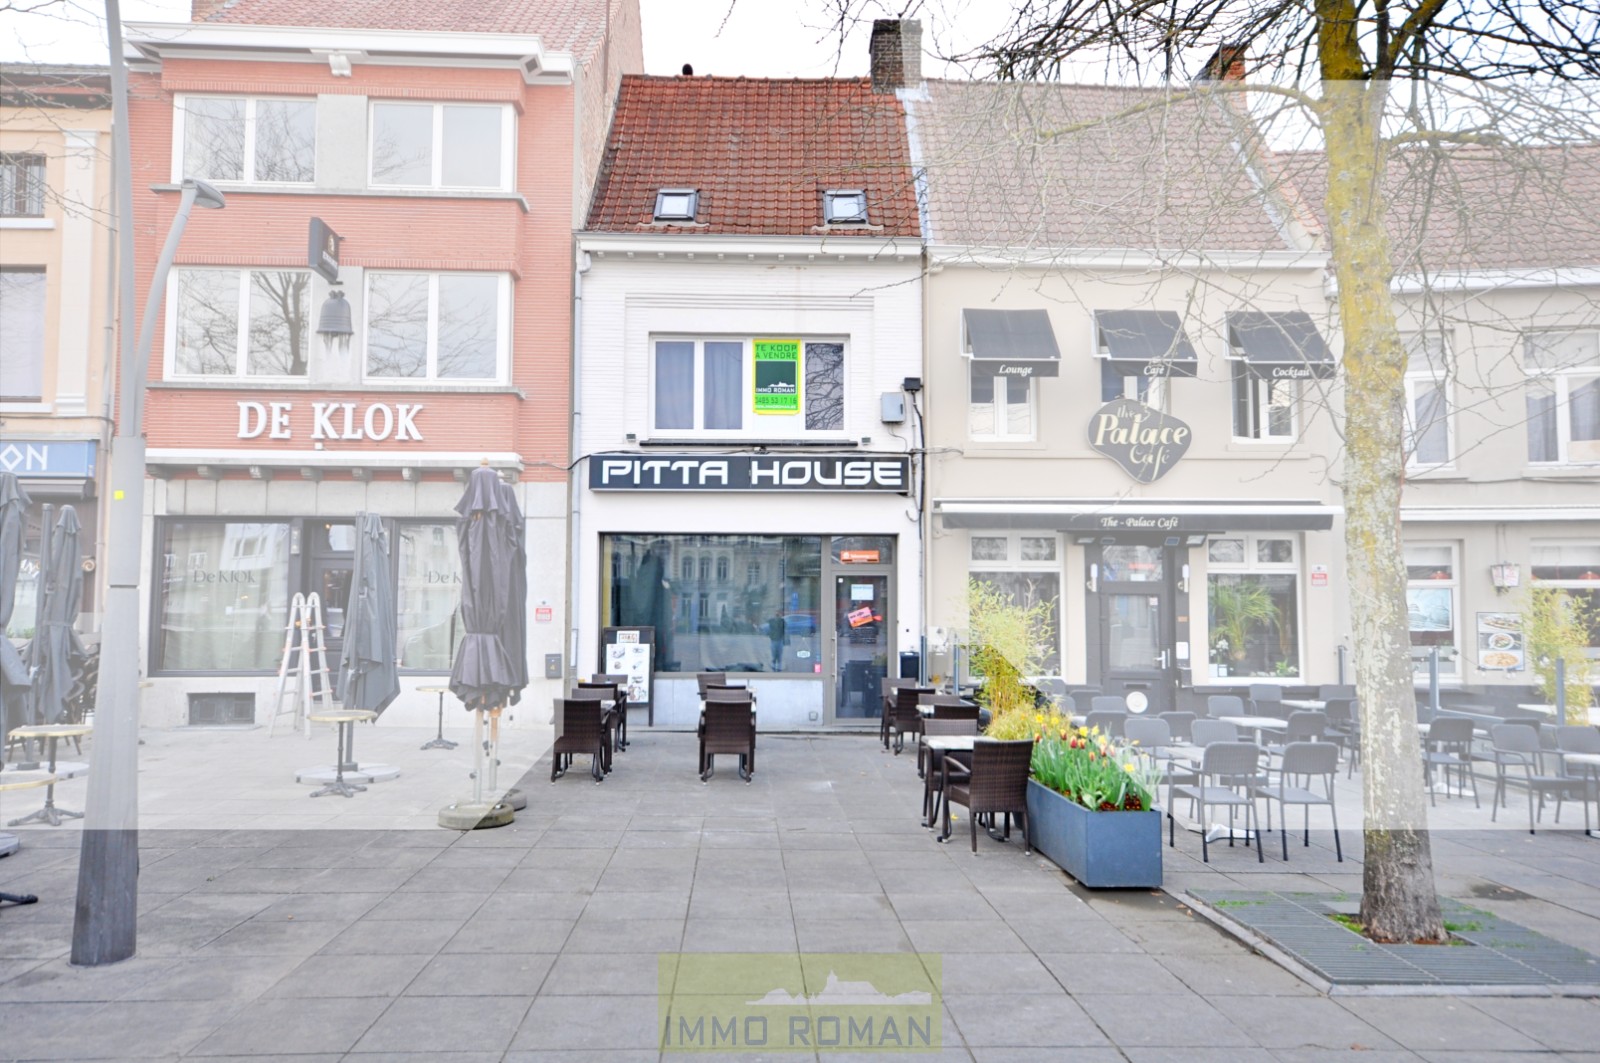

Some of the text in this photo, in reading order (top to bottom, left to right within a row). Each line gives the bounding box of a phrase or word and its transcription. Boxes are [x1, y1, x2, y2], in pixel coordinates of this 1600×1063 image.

[755, 344, 797, 352] TE KOOP
[998, 364, 1033, 377] Lounge
[1272, 366, 1310, 379] Cocktail
[237, 401, 424, 441] DE KLOK
[1093, 413, 1189, 446] Palace
[1129, 444, 1170, 481] Café
[602, 460, 902, 486] PITTA HOUSE
[1100, 516, 1119, 528] The
[1125, 516, 1156, 528] Palace
[1157, 516, 1179, 531] Café
[193, 570, 216, 583] De
[428, 570, 449, 584] De
